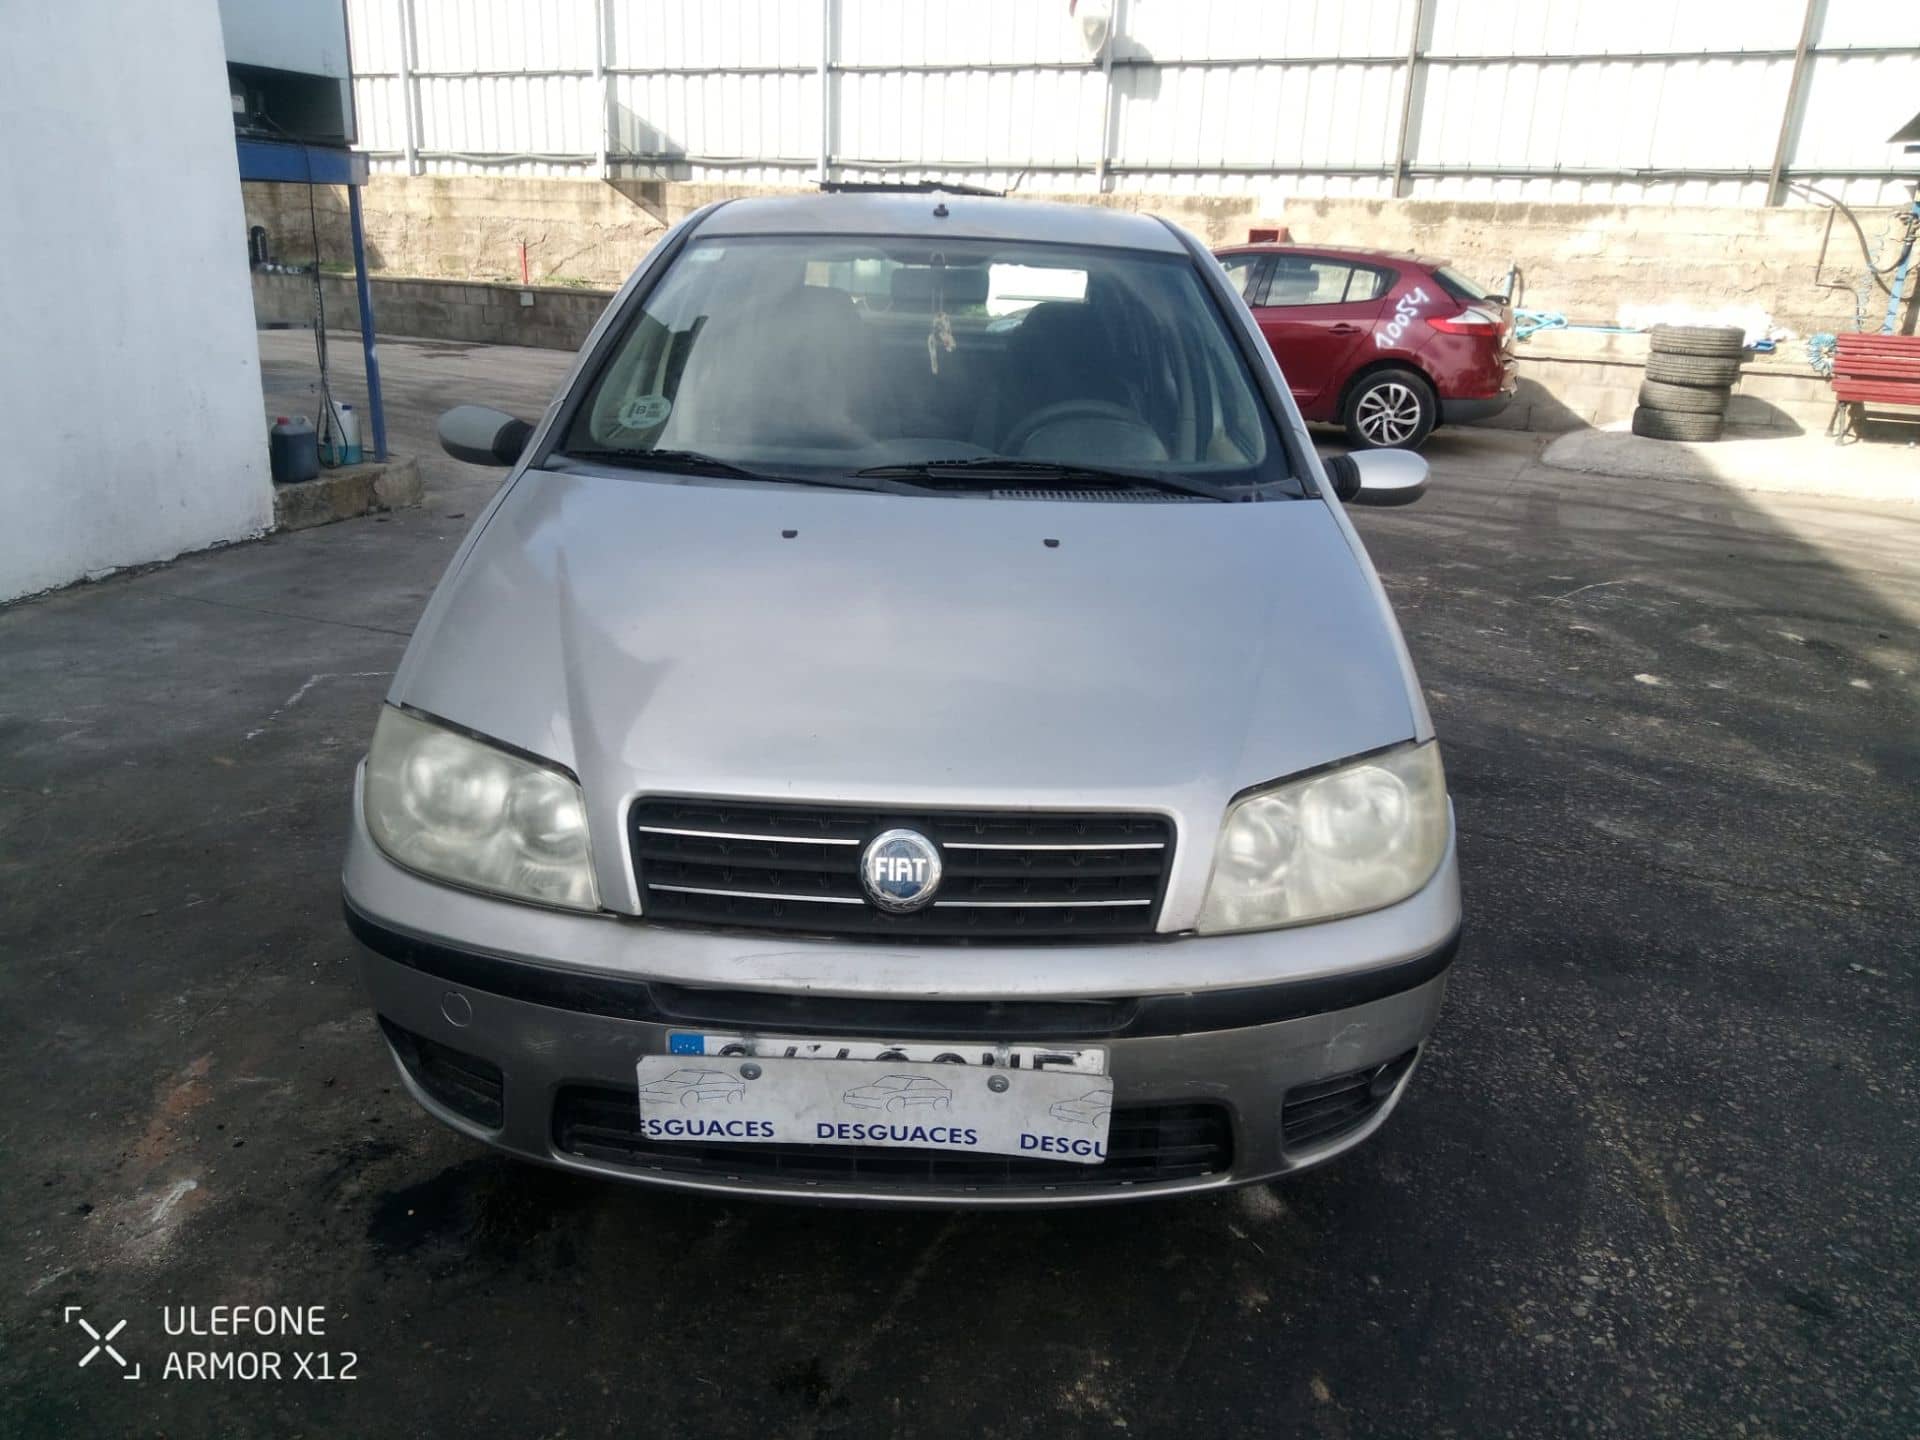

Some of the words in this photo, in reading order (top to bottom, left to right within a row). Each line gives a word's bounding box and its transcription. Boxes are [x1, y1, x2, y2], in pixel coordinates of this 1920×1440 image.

[1375, 287, 1430, 350] 10054
[875, 857, 926, 882] FIAT
[816, 1122, 978, 1145] DESGUACES
